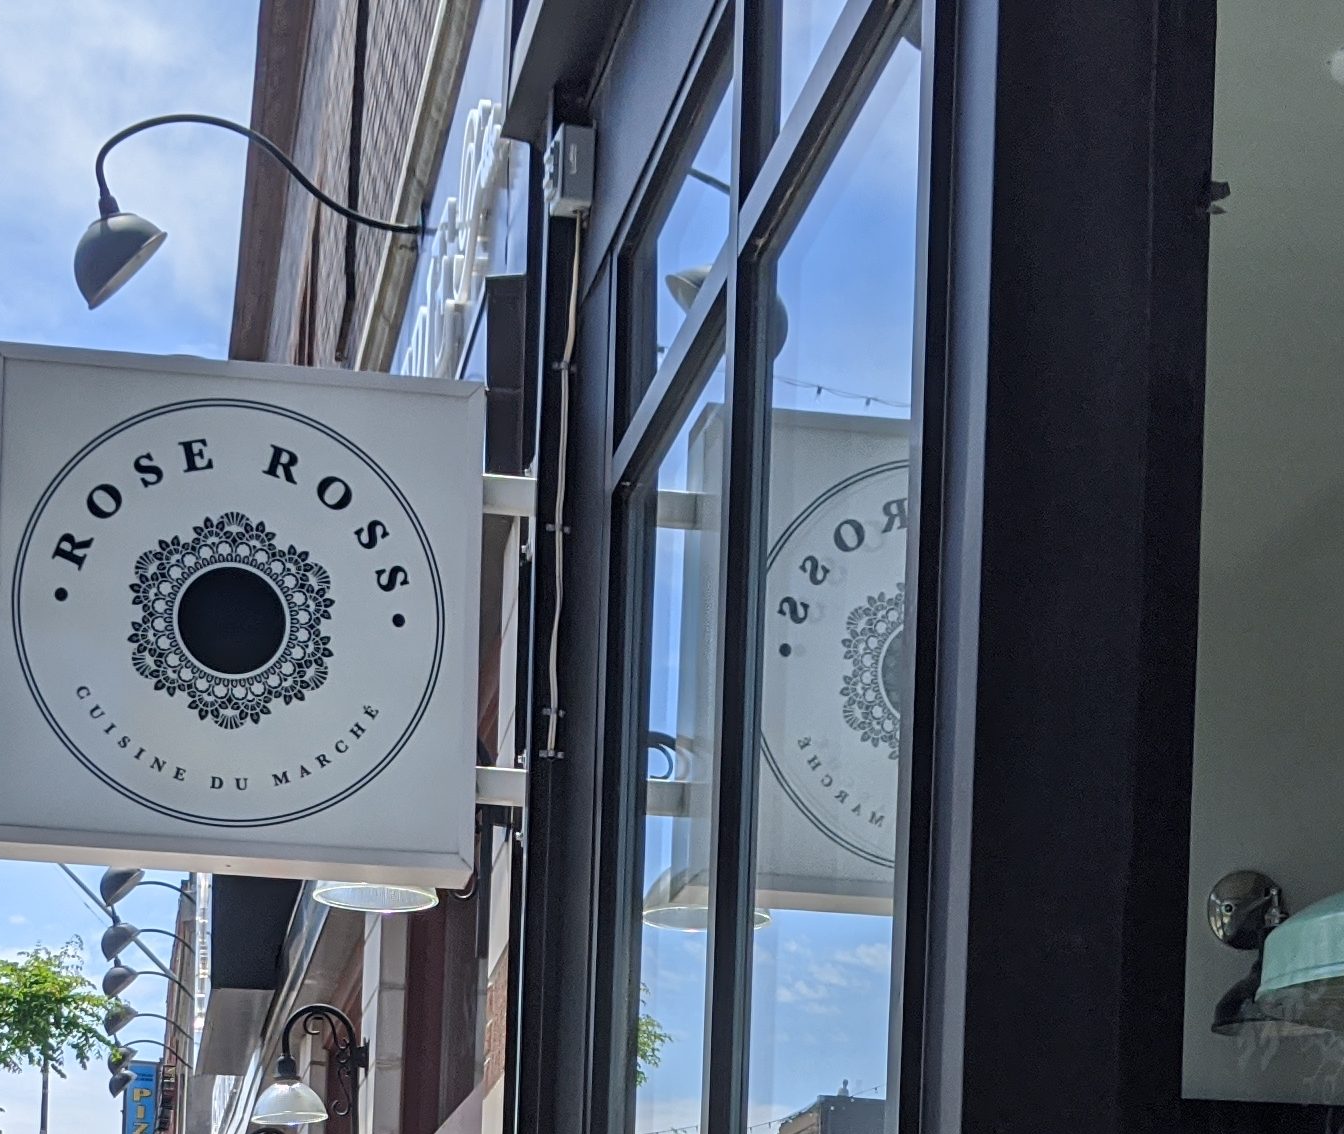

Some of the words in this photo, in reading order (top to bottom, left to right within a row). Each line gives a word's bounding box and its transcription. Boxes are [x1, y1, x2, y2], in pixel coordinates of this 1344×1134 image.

[52, 438, 214, 571] ROSE
[262, 443, 411, 595] ROSS
[74, 684, 187, 783] CUISINE
[209, 775, 250, 792] DU
[272, 702, 381, 788] MARCHÉ
